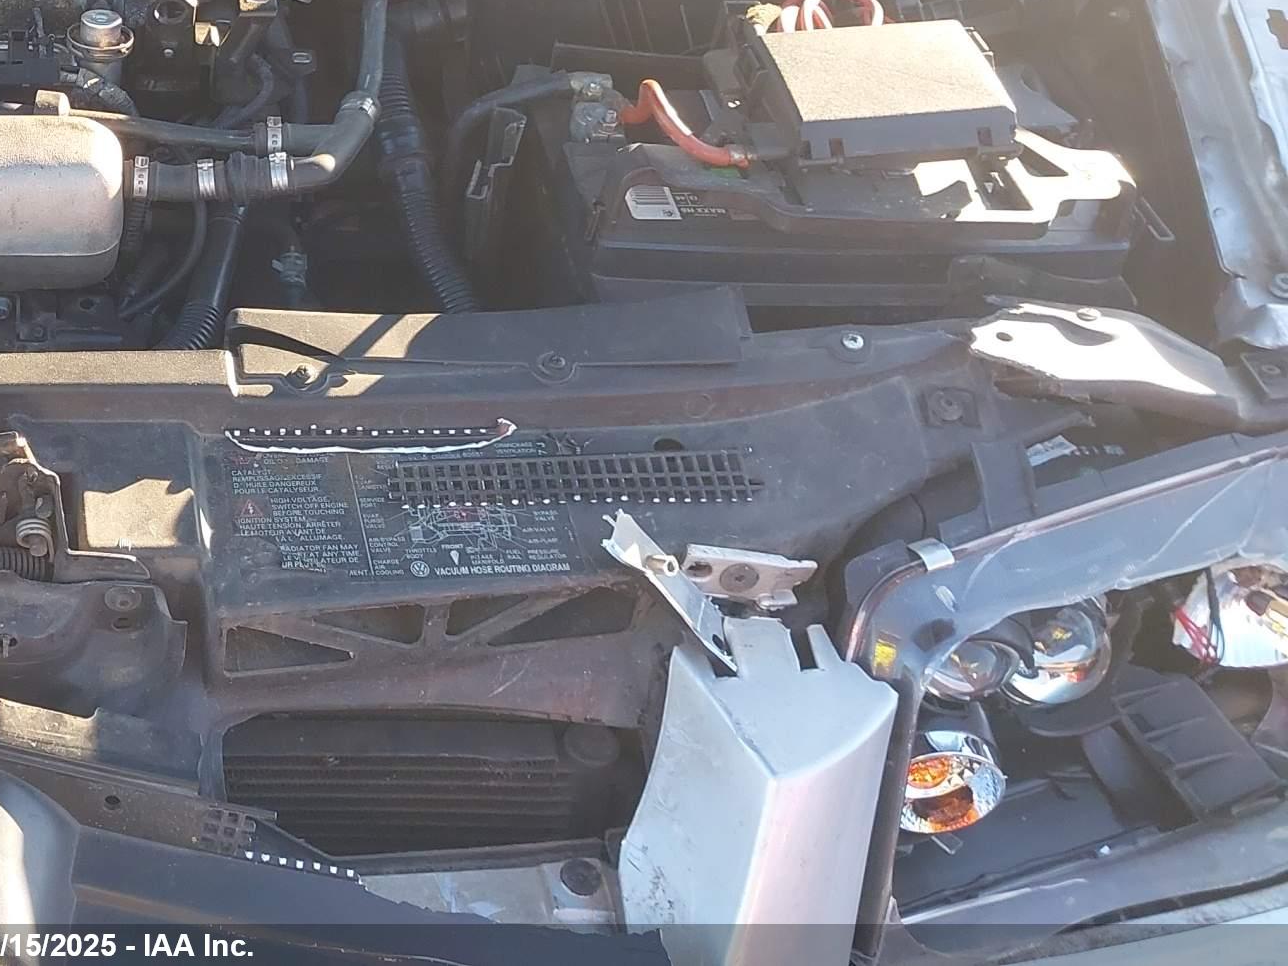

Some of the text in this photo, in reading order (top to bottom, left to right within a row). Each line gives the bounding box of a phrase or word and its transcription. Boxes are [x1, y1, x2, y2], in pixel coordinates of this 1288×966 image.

[268, 486, 319, 494] CATALYSEUR
[306, 520, 342, 528] ARRÊTER
[435, 563, 570, 575] VACUUM HOSE ROUTING DIAGRAM
